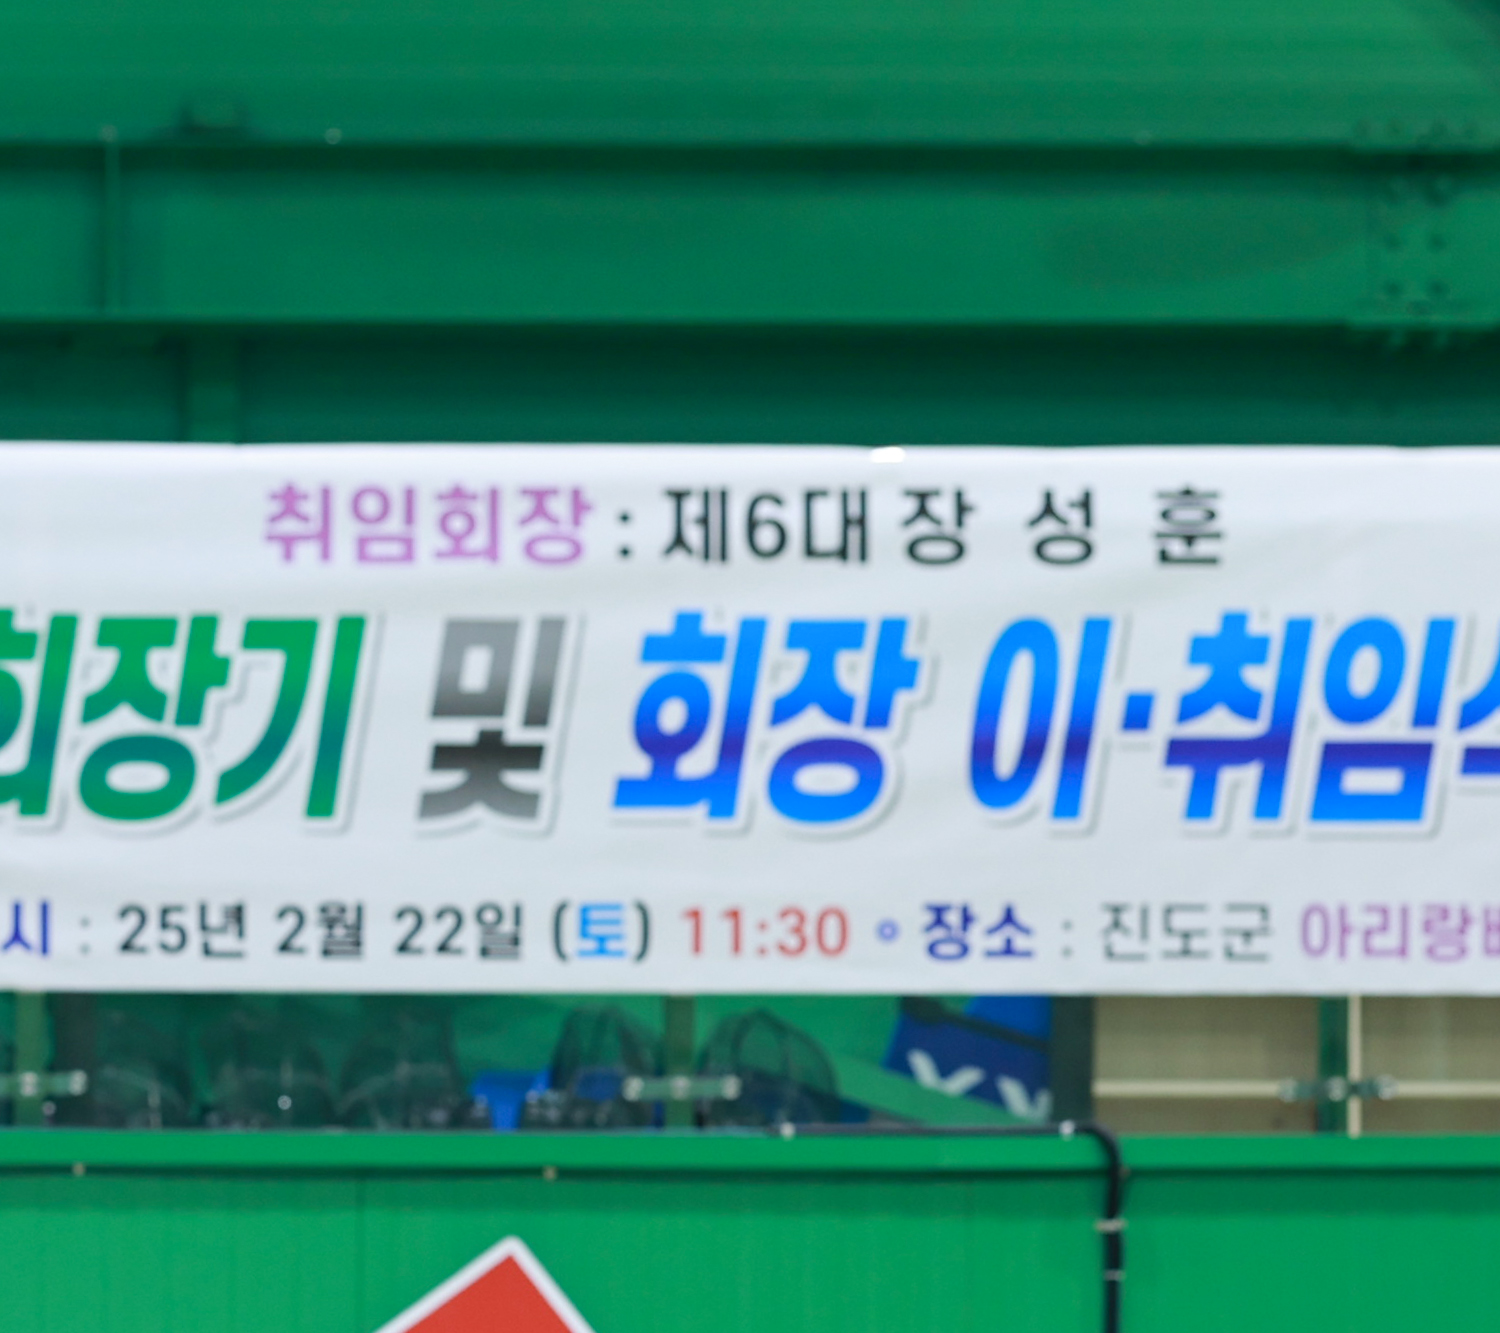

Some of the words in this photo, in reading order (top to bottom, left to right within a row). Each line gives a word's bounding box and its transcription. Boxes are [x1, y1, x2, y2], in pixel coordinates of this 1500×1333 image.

[263, 482, 594, 566] 취임회장
[416, 613, 570, 823] 및
[611, 610, 922, 824] 회장
[115, 900, 248, 962] 25년
[274, 900, 368, 963] 2월
[393, 900, 526, 964] 22일
[680, 907, 852, 960] 11:30
[921, 901, 1037, 963] 장소
[1096, 901, 1274, 963] 진도군
